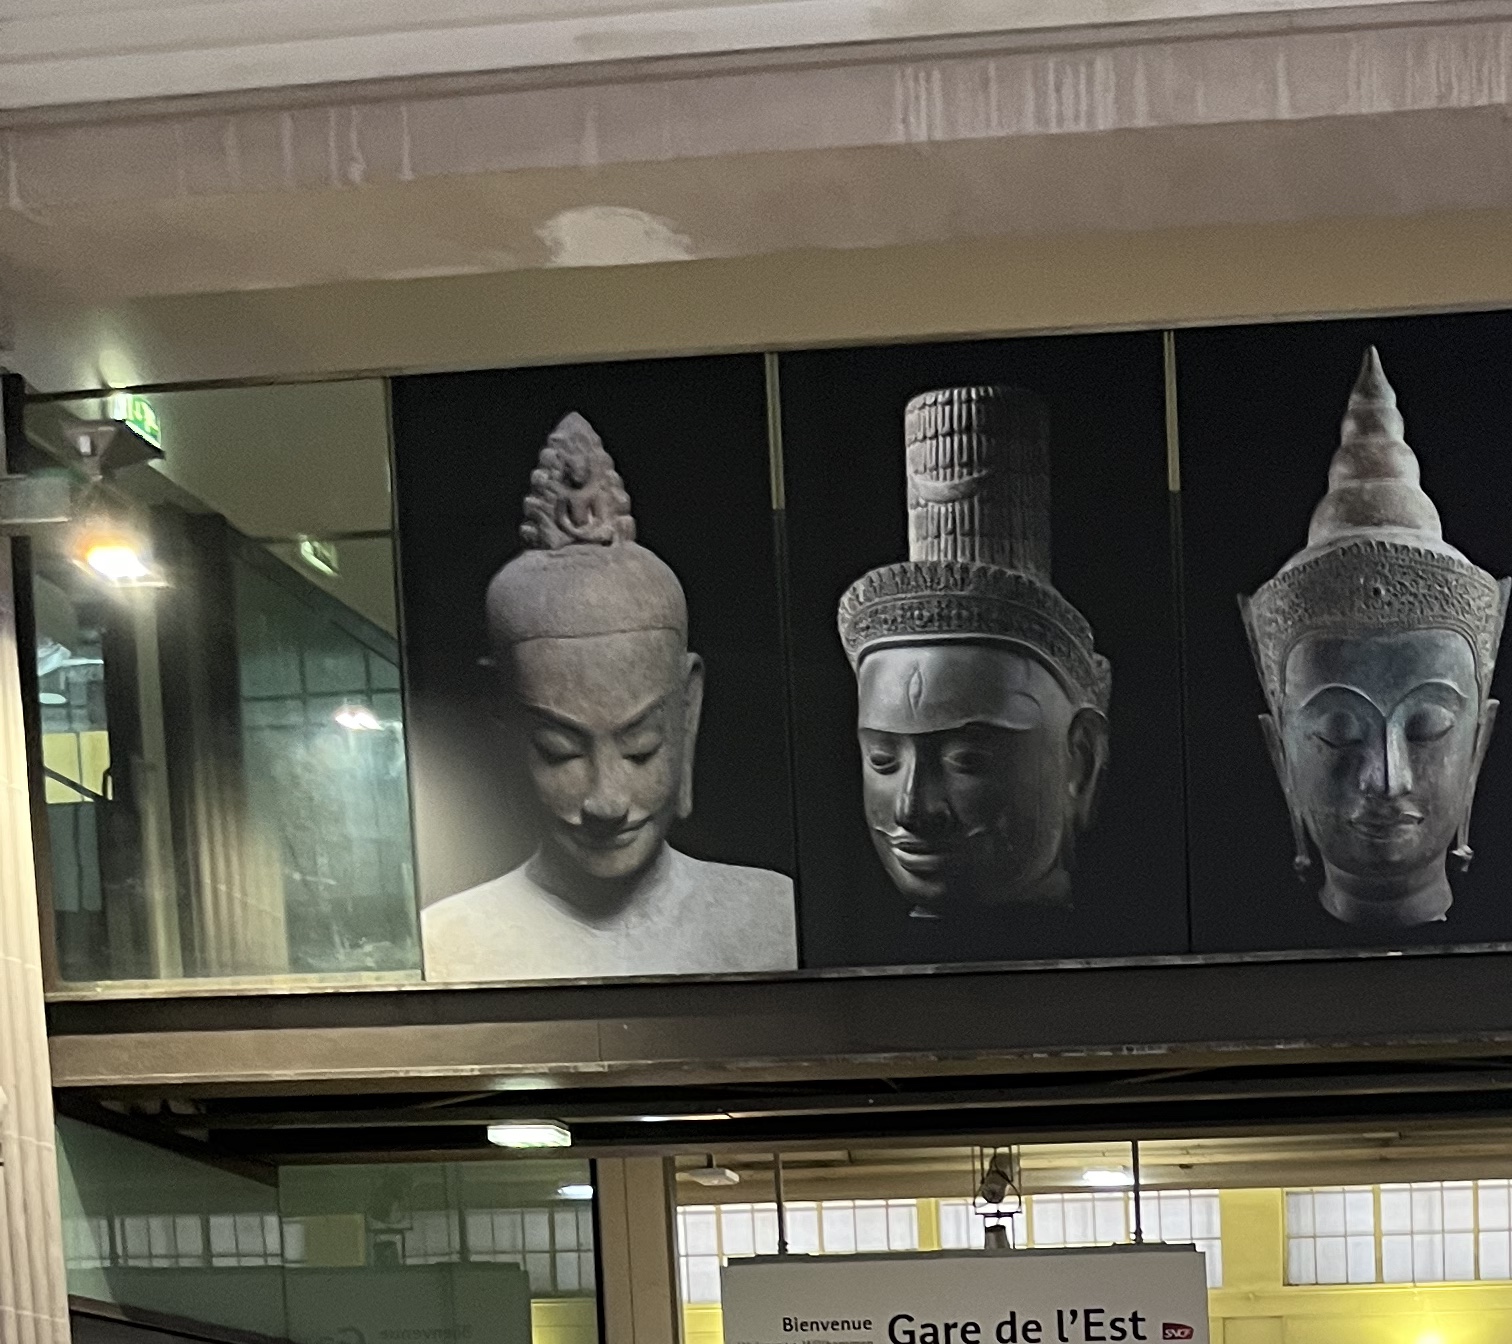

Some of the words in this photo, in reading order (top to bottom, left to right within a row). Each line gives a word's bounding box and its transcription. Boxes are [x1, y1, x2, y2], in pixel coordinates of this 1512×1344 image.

[782, 1316, 873, 1332] Bienvenue
[995, 1310, 1043, 1344] de
[1056, 1308, 1147, 1342] l'Est
